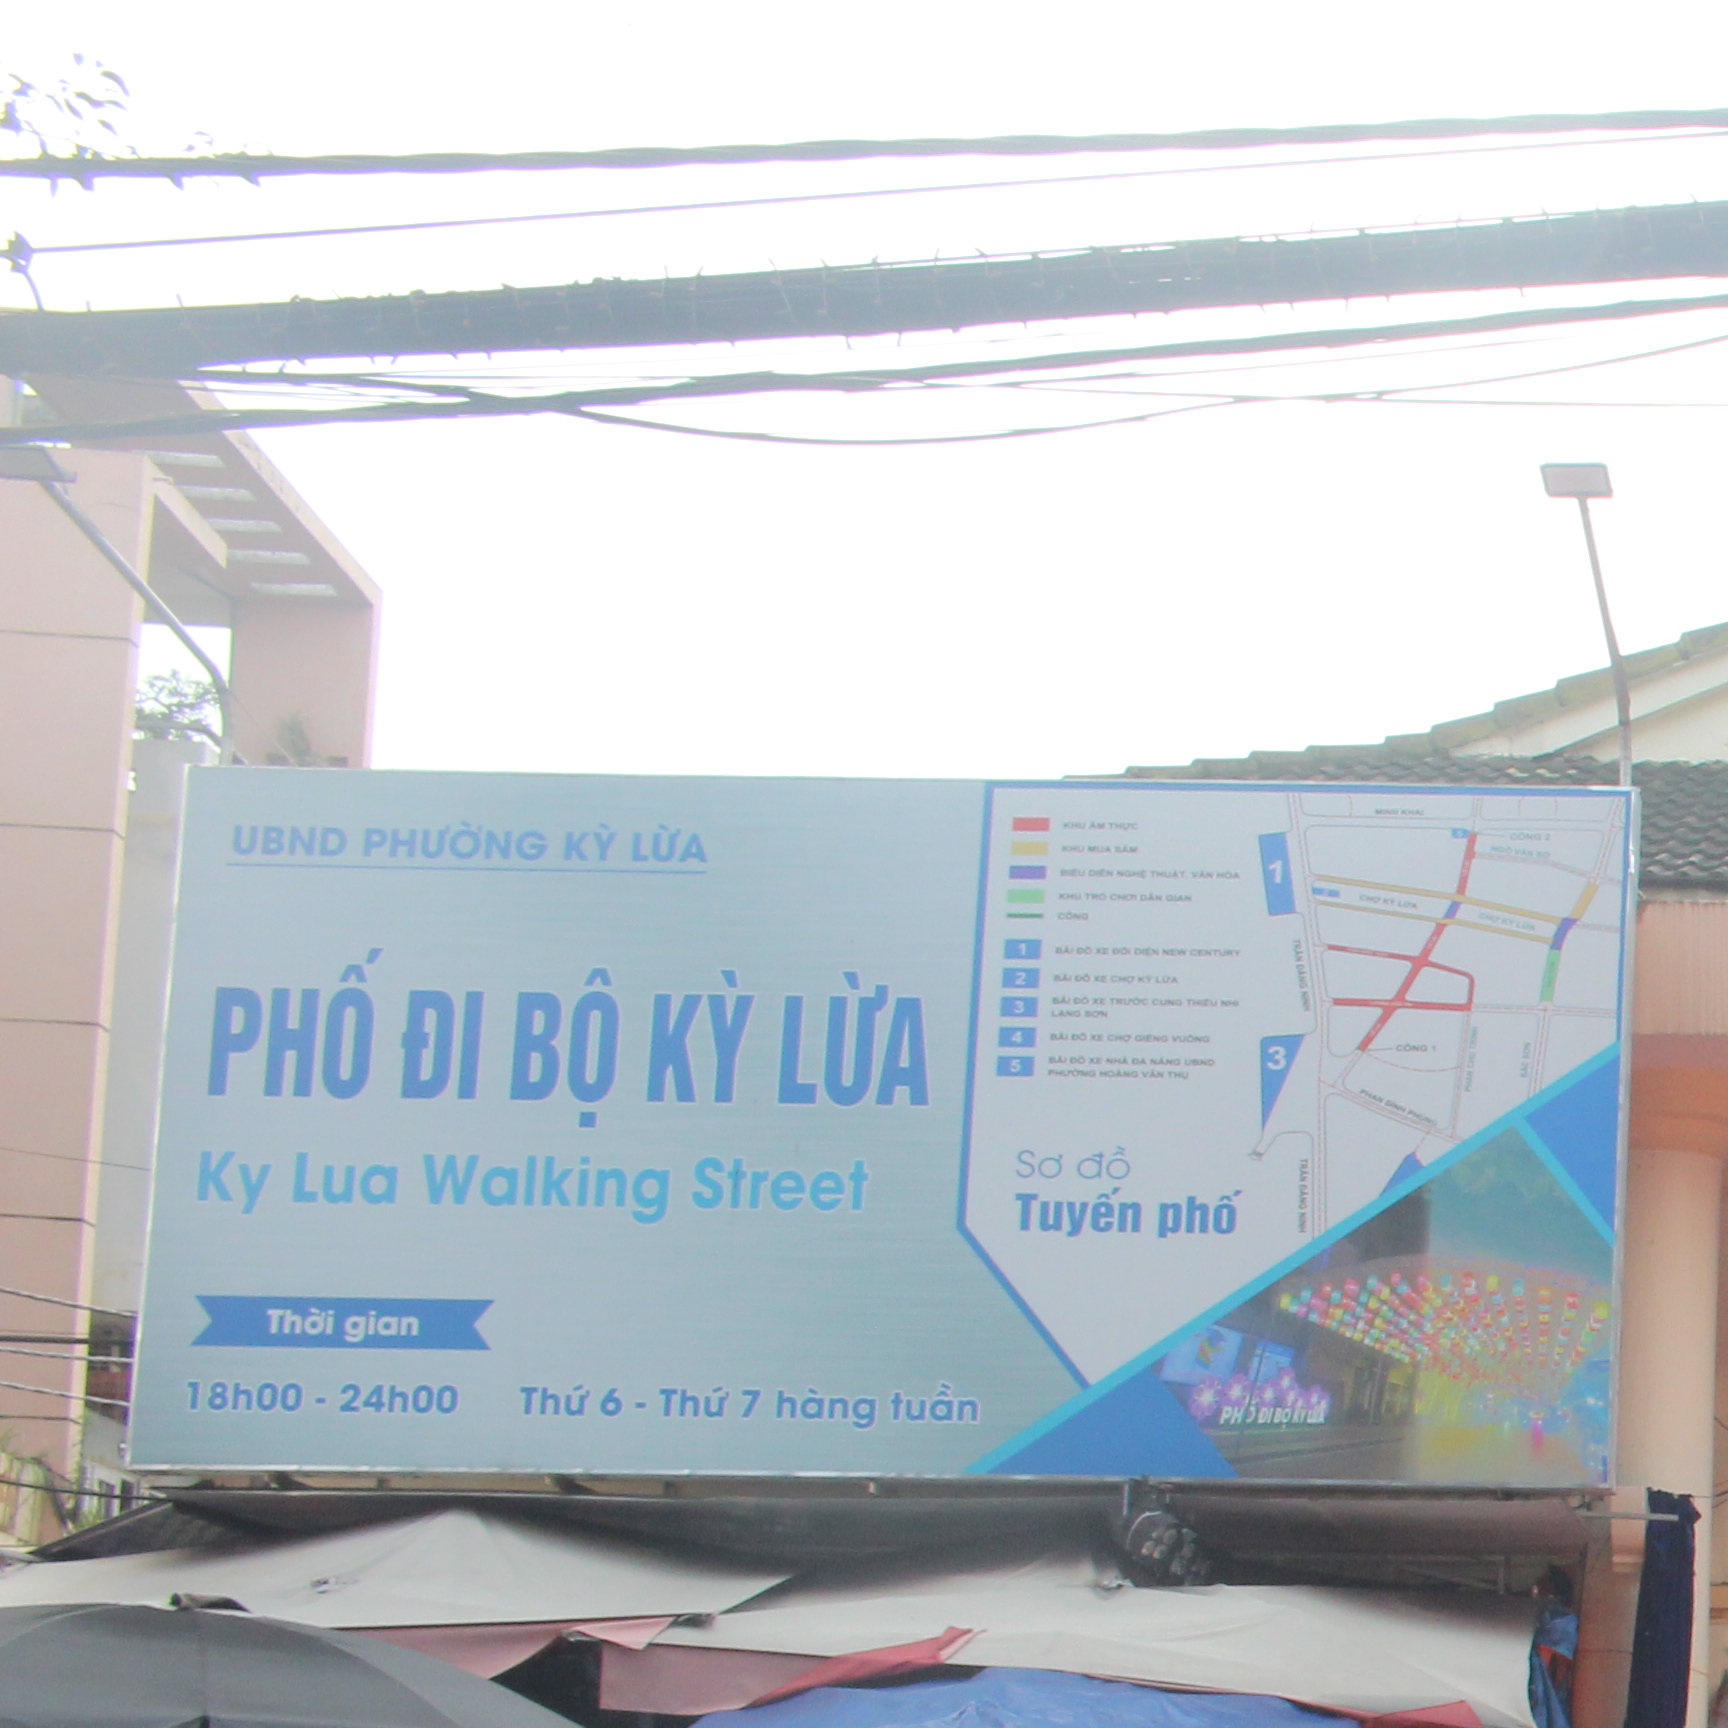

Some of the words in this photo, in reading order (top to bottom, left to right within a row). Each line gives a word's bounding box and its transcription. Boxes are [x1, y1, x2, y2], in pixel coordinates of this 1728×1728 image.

[232, 826, 347, 857] UBND
[363, 823, 549, 862] PHƯỜNG
[564, 823, 616, 863] KỲ
[630, 824, 708, 865] LỪA
[1268, 860, 1285, 883] 1
[1015, 972, 1026, 985] 2
[1014, 1001, 1025, 1013] 3
[207, 947, 384, 1100] PHỐ
[401, 989, 484, 1100] ĐI
[510, 967, 621, 1128] BỘ
[646, 970, 754, 1104] KỲ
[777, 972, 930, 1107] LỪA
[1011, 1032, 1022, 1044] 4
[1010, 1060, 1021, 1072] 5
[1266, 1046, 1287, 1070] 3
[1015, 1147, 1065, 1181] Sơ
[1077, 1146, 1132, 1181] đồ
[197, 1151, 271, 1214] Ky
[292, 1152, 399, 1206] Lua
[422, 1153, 670, 1226] Walking
[690, 1157, 868, 1212] Street
[1014, 1187, 1143, 1236] Tuyến
[1157, 1190, 1243, 1240] phố
[267, 1307, 333, 1338] Thời
[344, 1311, 419, 1342] gian
[186, 1381, 303, 1413] 18h00
[340, 1384, 459, 1415] 24h00
[520, 1385, 587, 1418] Thứ
[600, 1388, 623, 1418] 6
[660, 1387, 728, 1420] Thứ
[741, 1390, 760, 1420] 7
[775, 1390, 876, 1430] hàng
[891, 1381, 979, 1424] tuần
